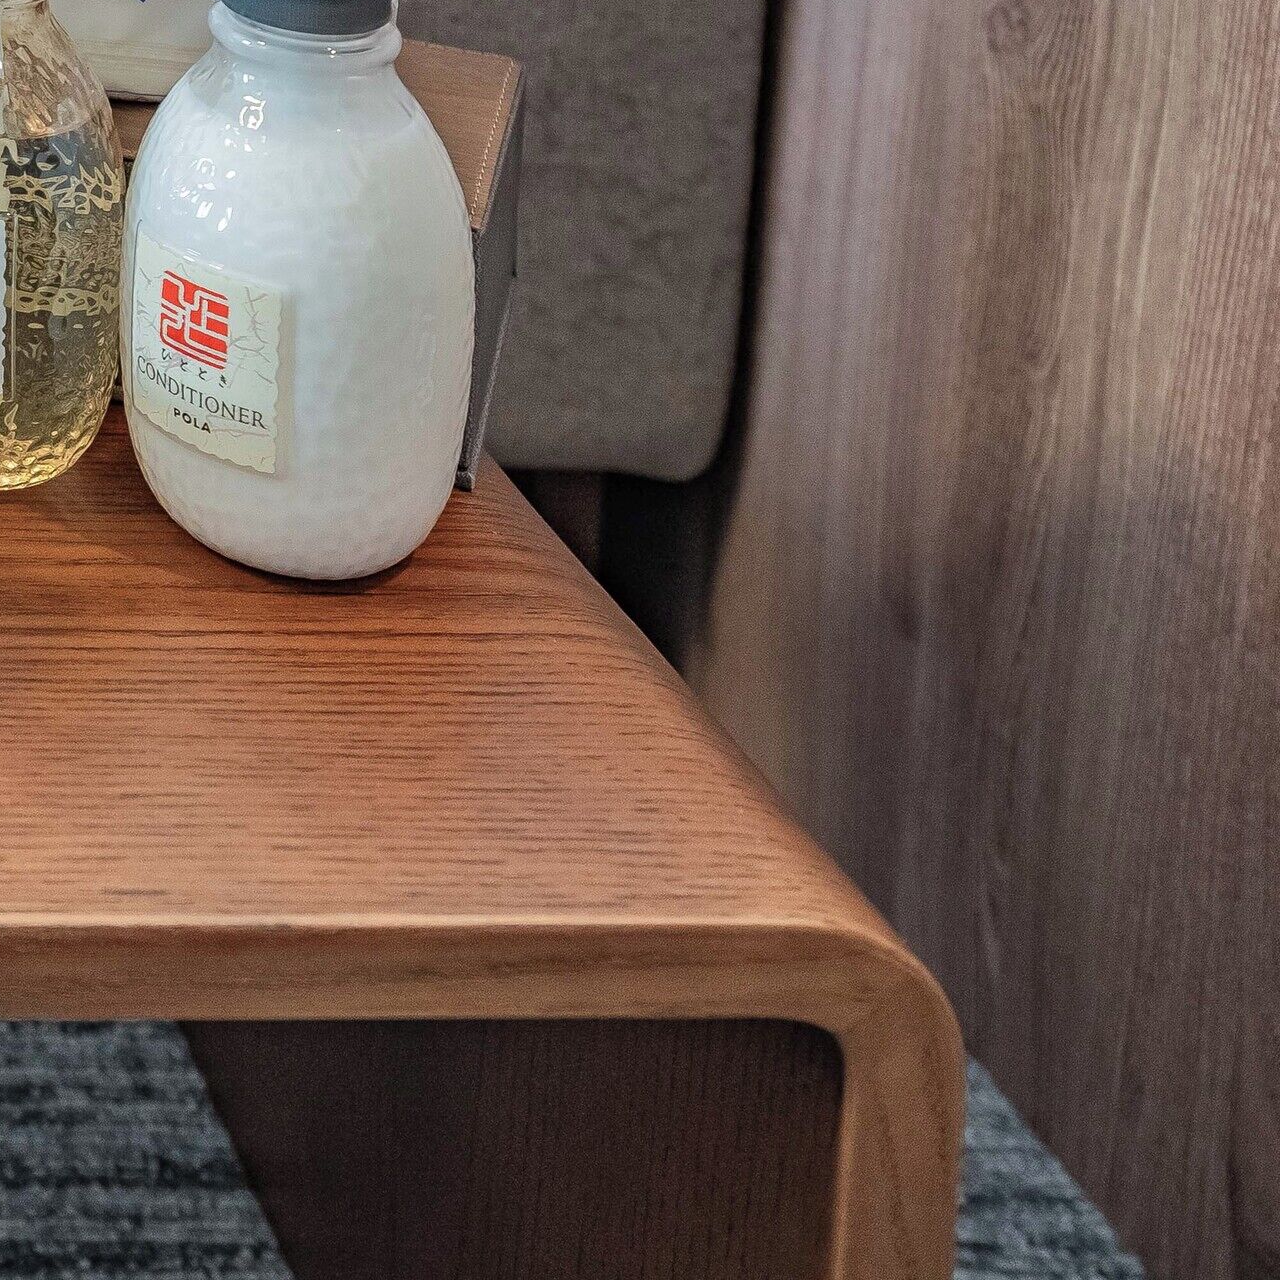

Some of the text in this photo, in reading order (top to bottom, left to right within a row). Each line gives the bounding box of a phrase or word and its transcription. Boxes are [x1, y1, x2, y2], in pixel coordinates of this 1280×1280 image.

[161, 348, 228, 388] ひととき
[137, 355, 268, 430] CONDITIONER
[173, 408, 211, 433] POLA
